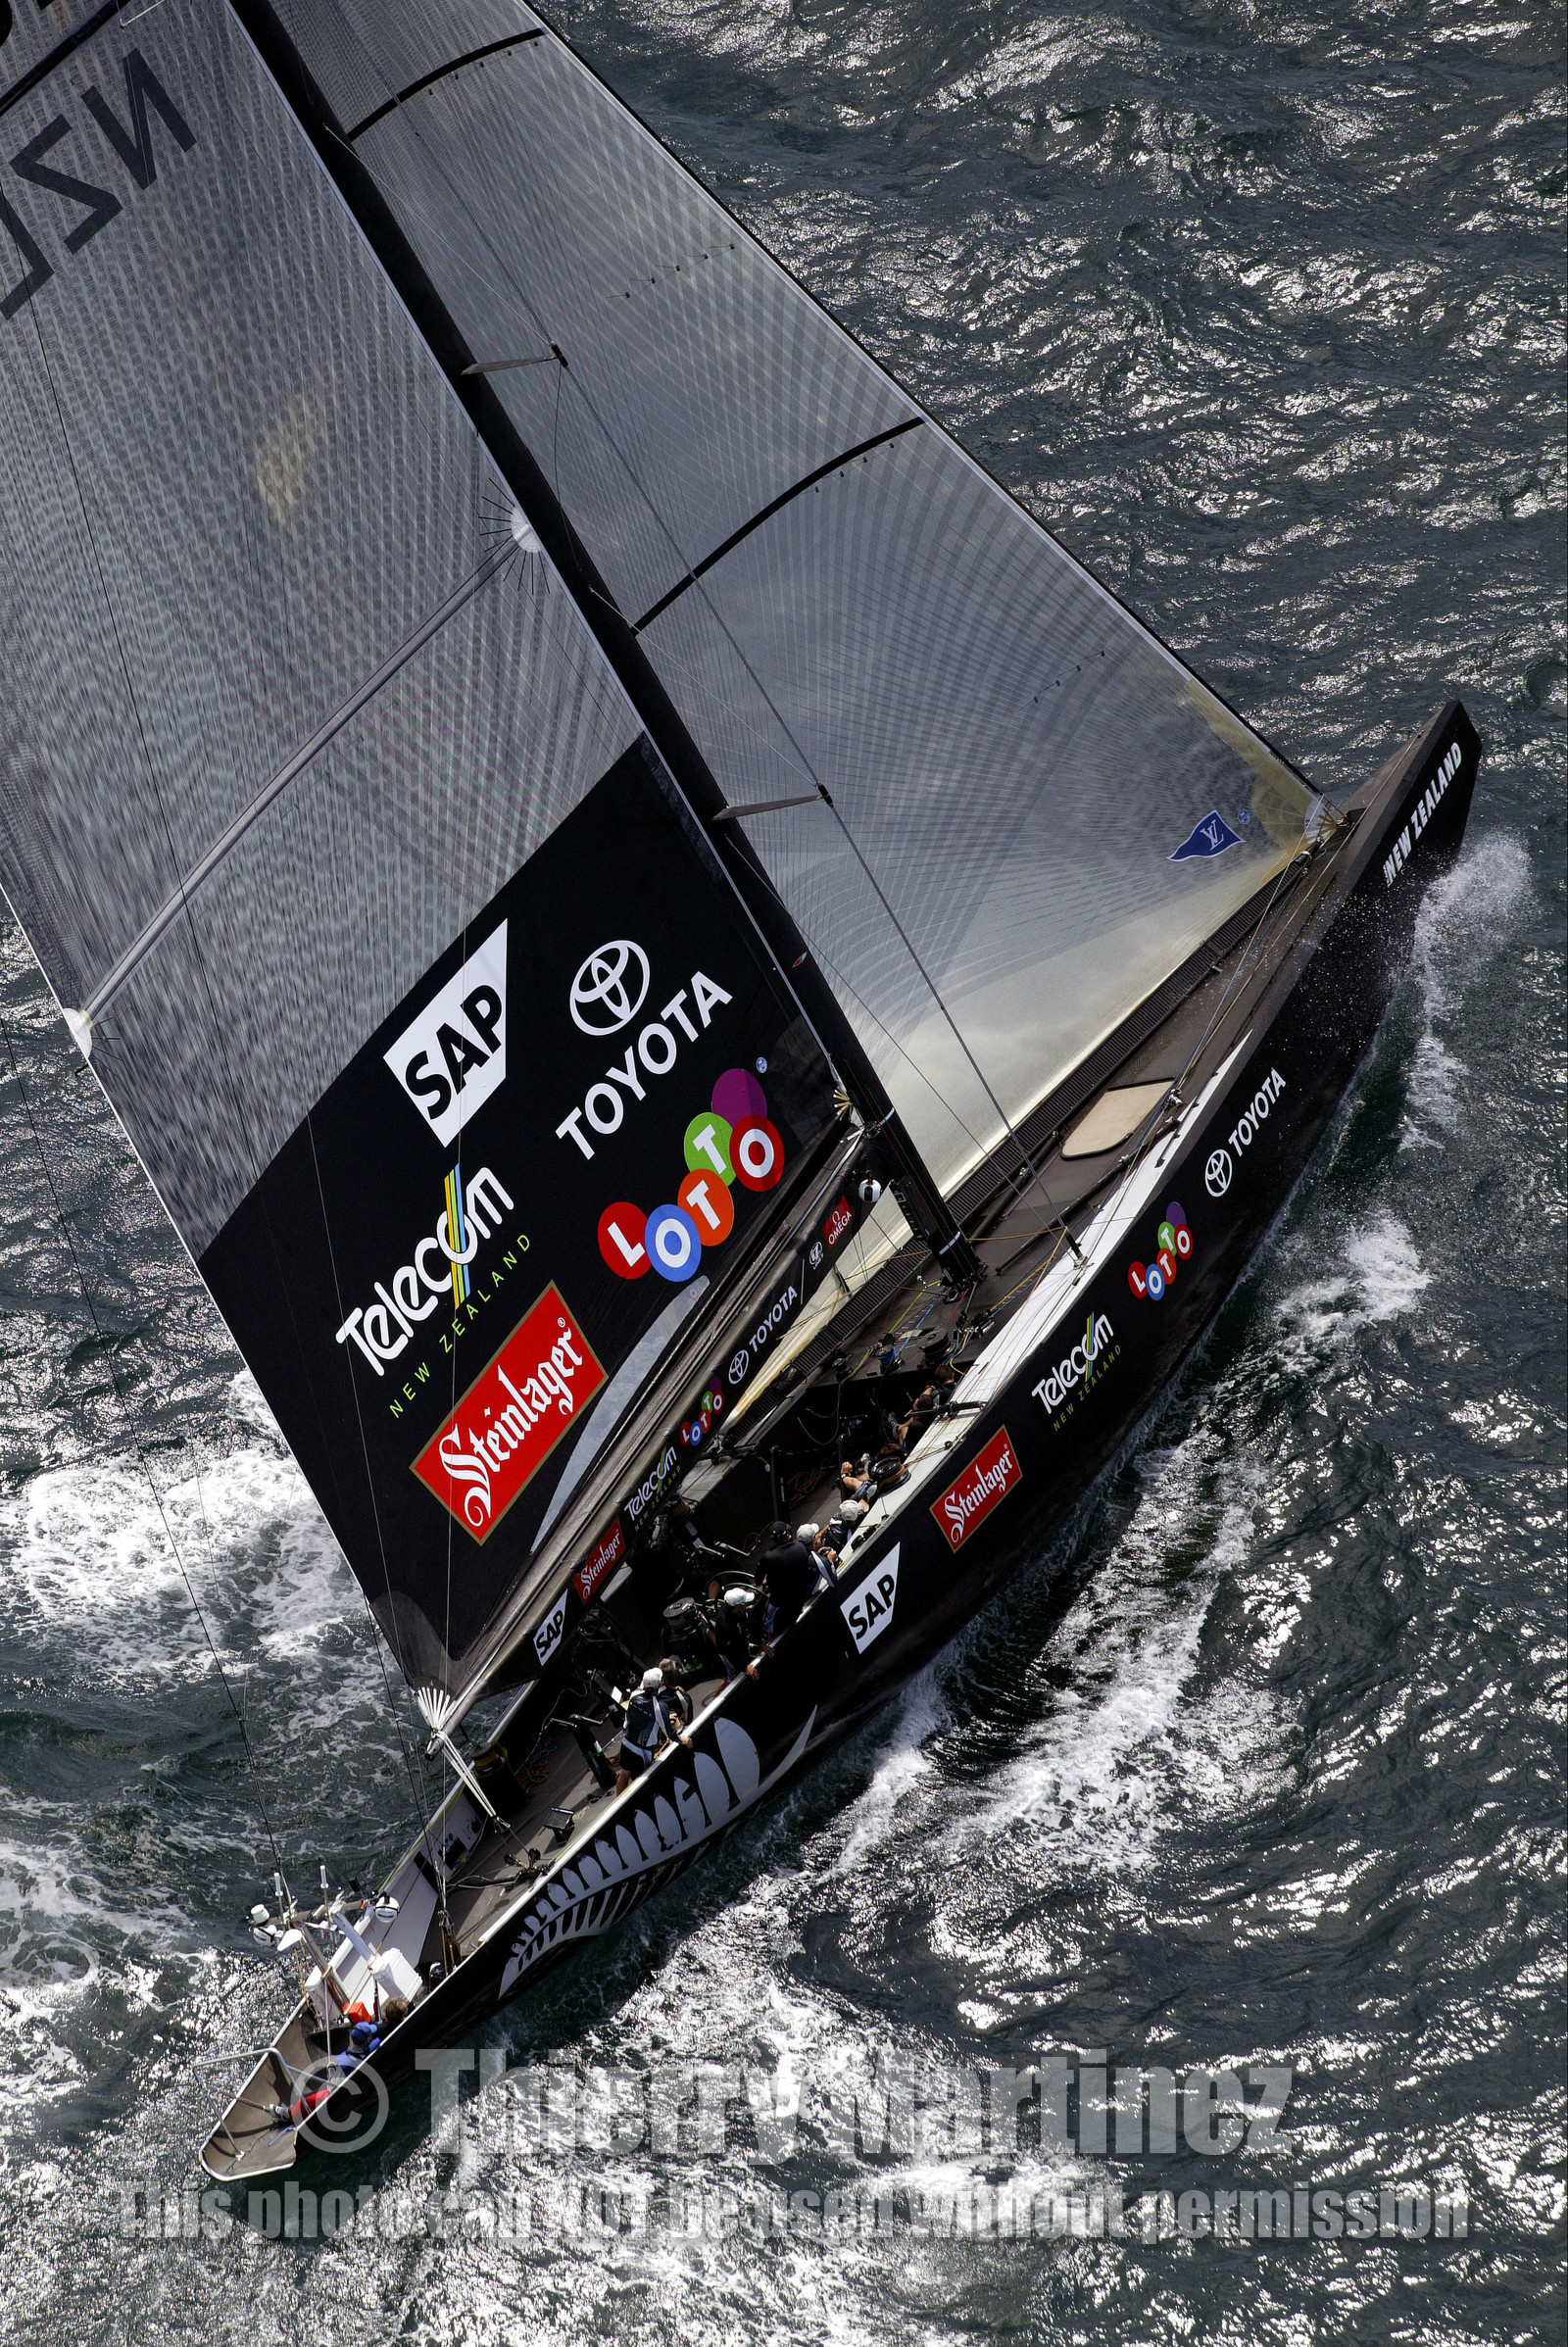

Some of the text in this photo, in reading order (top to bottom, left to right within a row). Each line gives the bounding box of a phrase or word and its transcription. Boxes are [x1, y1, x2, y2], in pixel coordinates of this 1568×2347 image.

[1383, 742, 1462, 889] NEW ZEALAND
[404, 983, 503, 1121] SAP
[555, 971, 733, 1160] TOYOTA
[1228, 1067, 1287, 1158] TOYOTA
[607, 1121, 776, 1270] LOTTO
[828, 1210, 853, 1246] OMEGA
[1133, 1226, 1192, 1296] LOTTO
[389, 1233, 531, 1419] NEW ZEALAND
[749, 1285, 799, 1352] TOYOTA
[438, 1327, 583, 1528] Steinlager
[681, 1394, 723, 1443] LOTTO
[1053, 1344, 1123, 1432] NEW ZEALAND
[635, 1464, 682, 1532] NEW ZEALAND
[941, 1444, 1013, 1540] Steinlager
[580, 1529, 621, 1599] Steinlager
[848, 1573, 896, 1640] SAP
[535, 1608, 564, 1658] SAP
